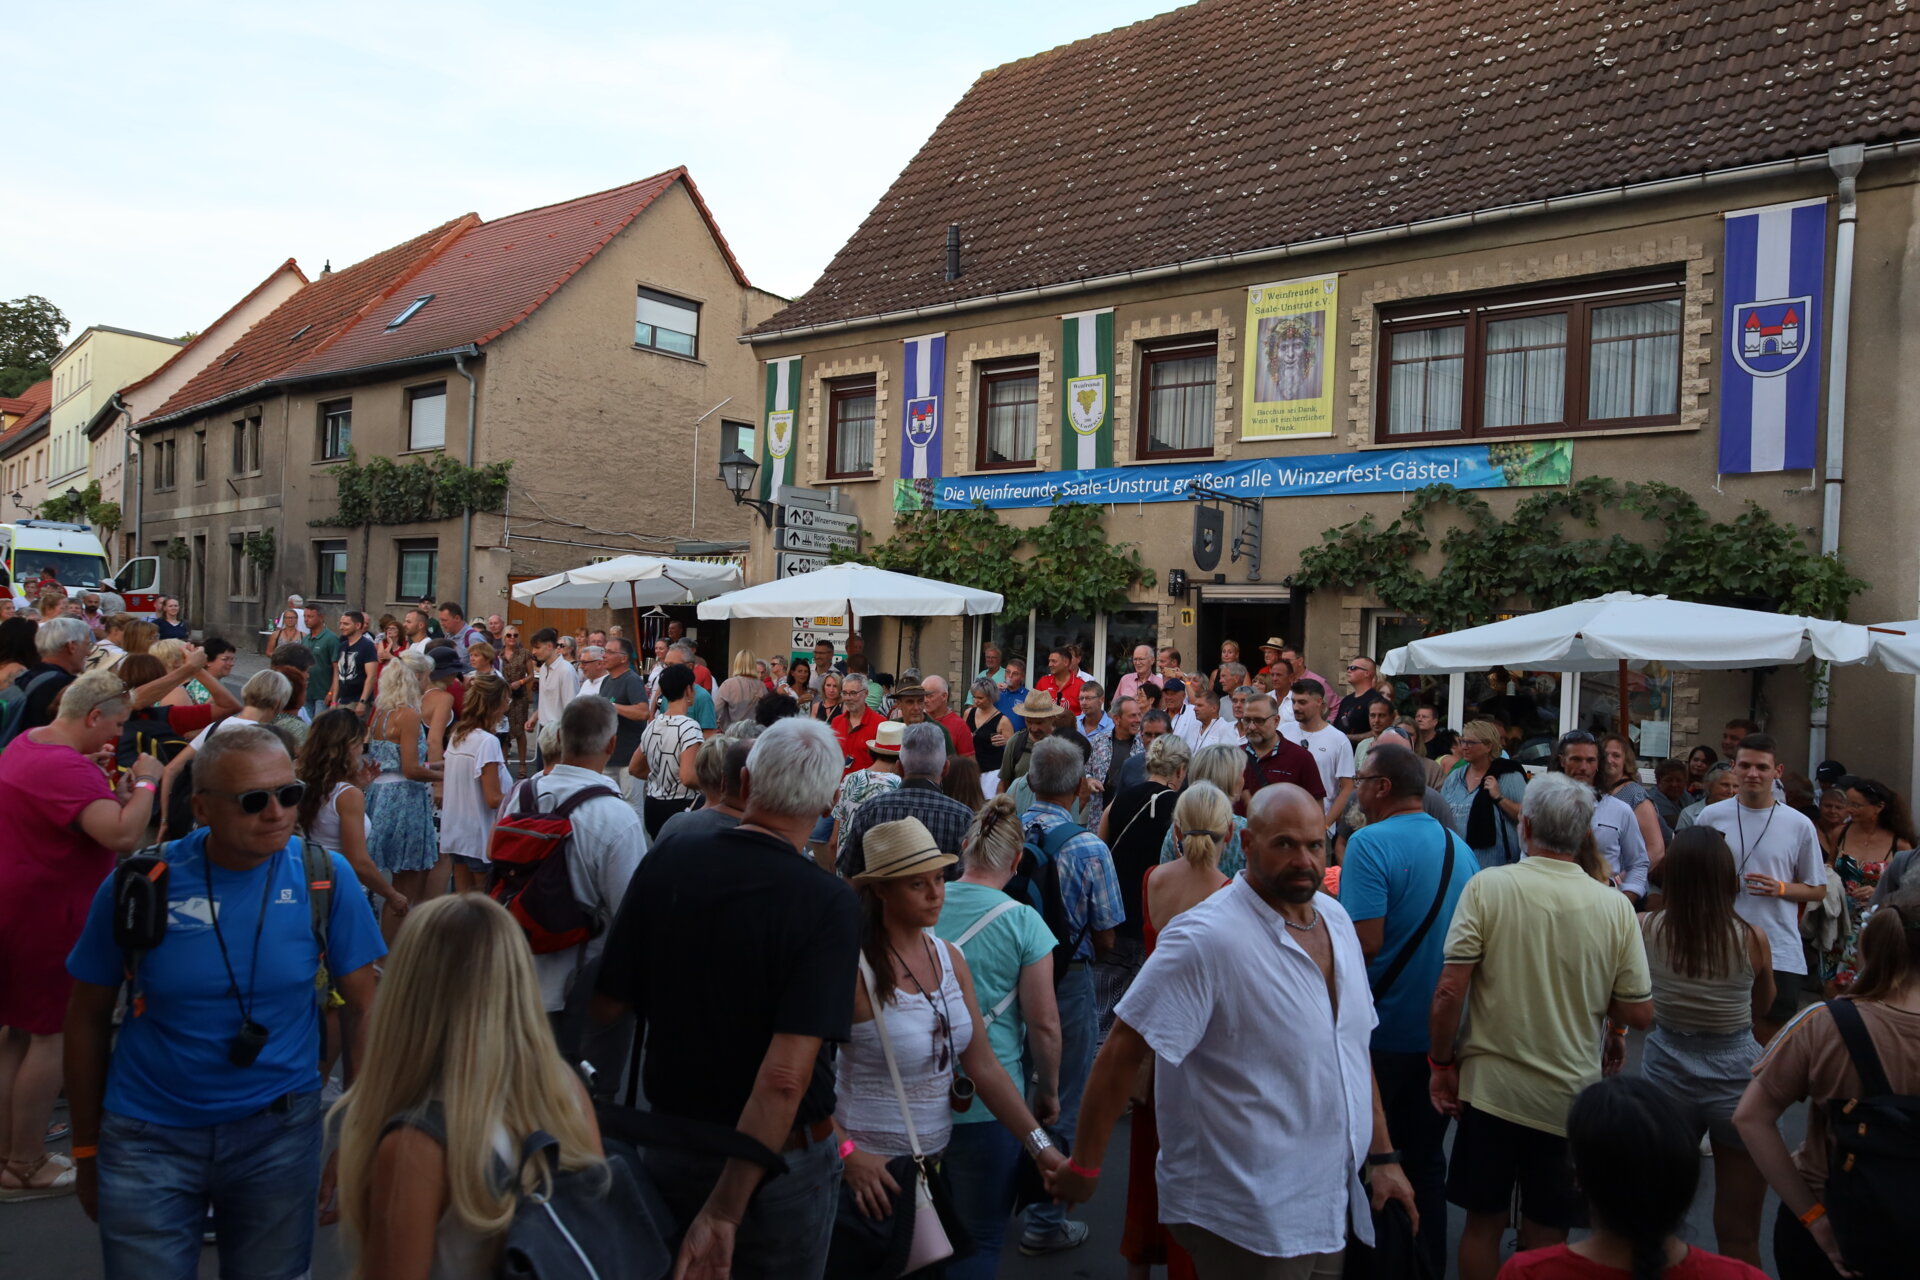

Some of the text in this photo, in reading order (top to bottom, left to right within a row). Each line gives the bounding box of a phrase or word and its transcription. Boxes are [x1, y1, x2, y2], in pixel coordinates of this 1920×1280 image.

[1267, 286, 1319, 300] Weinfreunde
[1255, 300, 1313, 315] Saale-Unstrut
[943, 486, 965, 501] Die
[969, 481, 1058, 500] Weinfreunde
[1062, 477, 1170, 496] Saale-Unstrut
[1240, 469, 1272, 487] alle
[1278, 458, 1458, 486] Winzerfest-Gäste!
